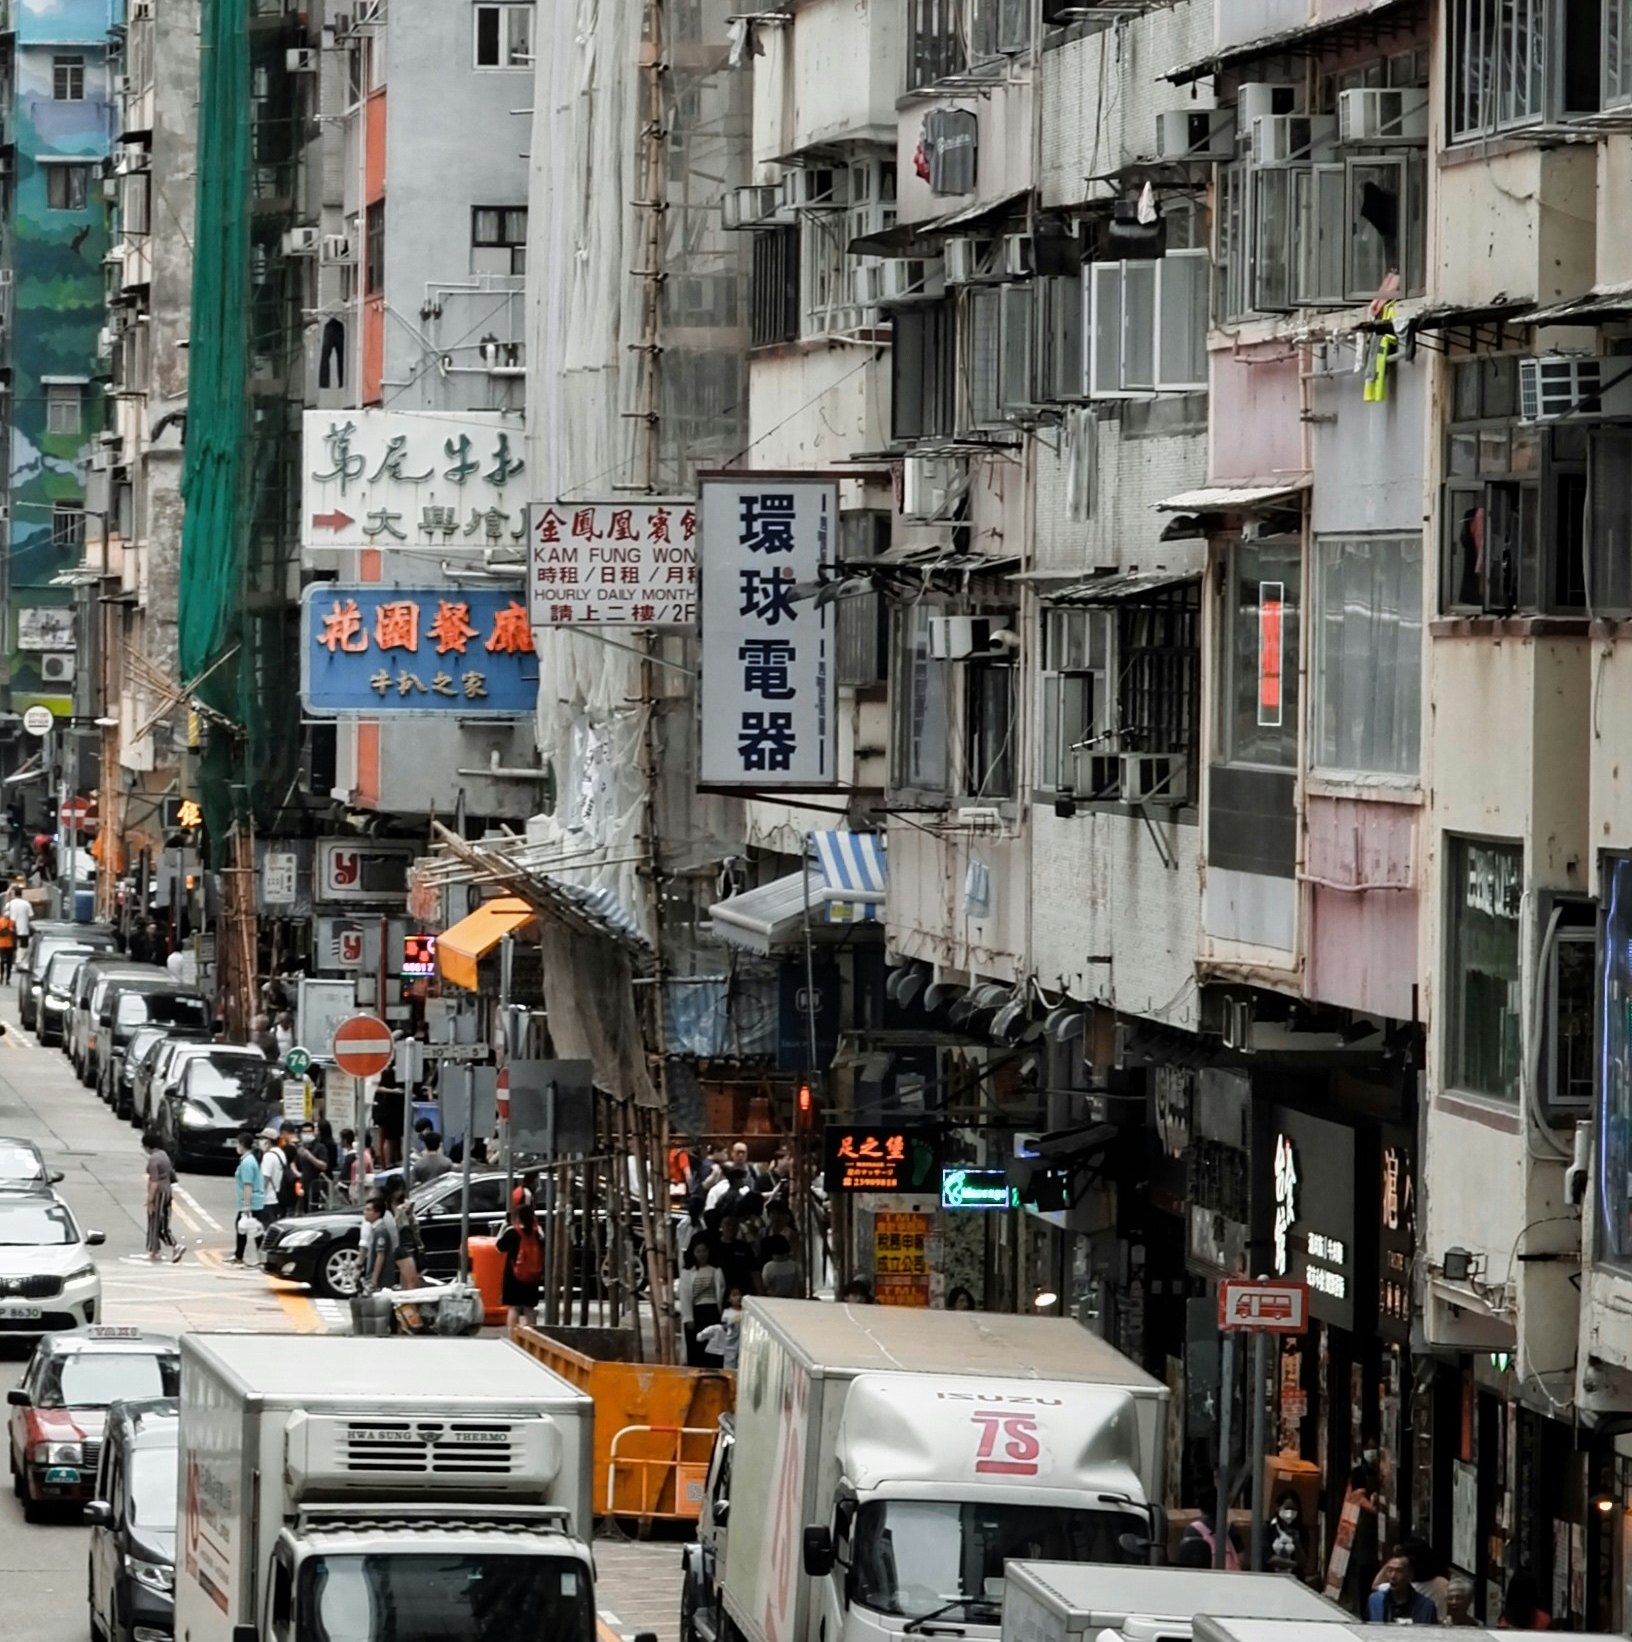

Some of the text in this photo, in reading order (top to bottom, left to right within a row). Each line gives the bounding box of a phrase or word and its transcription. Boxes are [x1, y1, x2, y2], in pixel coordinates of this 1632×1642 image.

[535, 548, 578, 563] KAM
[589, 548, 641, 563] FUNG
[535, 589, 590, 601] HOURLY
[598, 589, 636, 601] DAILY
[738, 494, 797, 771] 環球電器
[370, 669, 489, 698] 牛扒之家
[290, 1054, 307, 1067] 74
[95, 1327, 138, 1337] TAXI
[936, 1392, 1062, 1405] ISUZU
[347, 1431, 508, 1442] HWA SUNG THERMO
